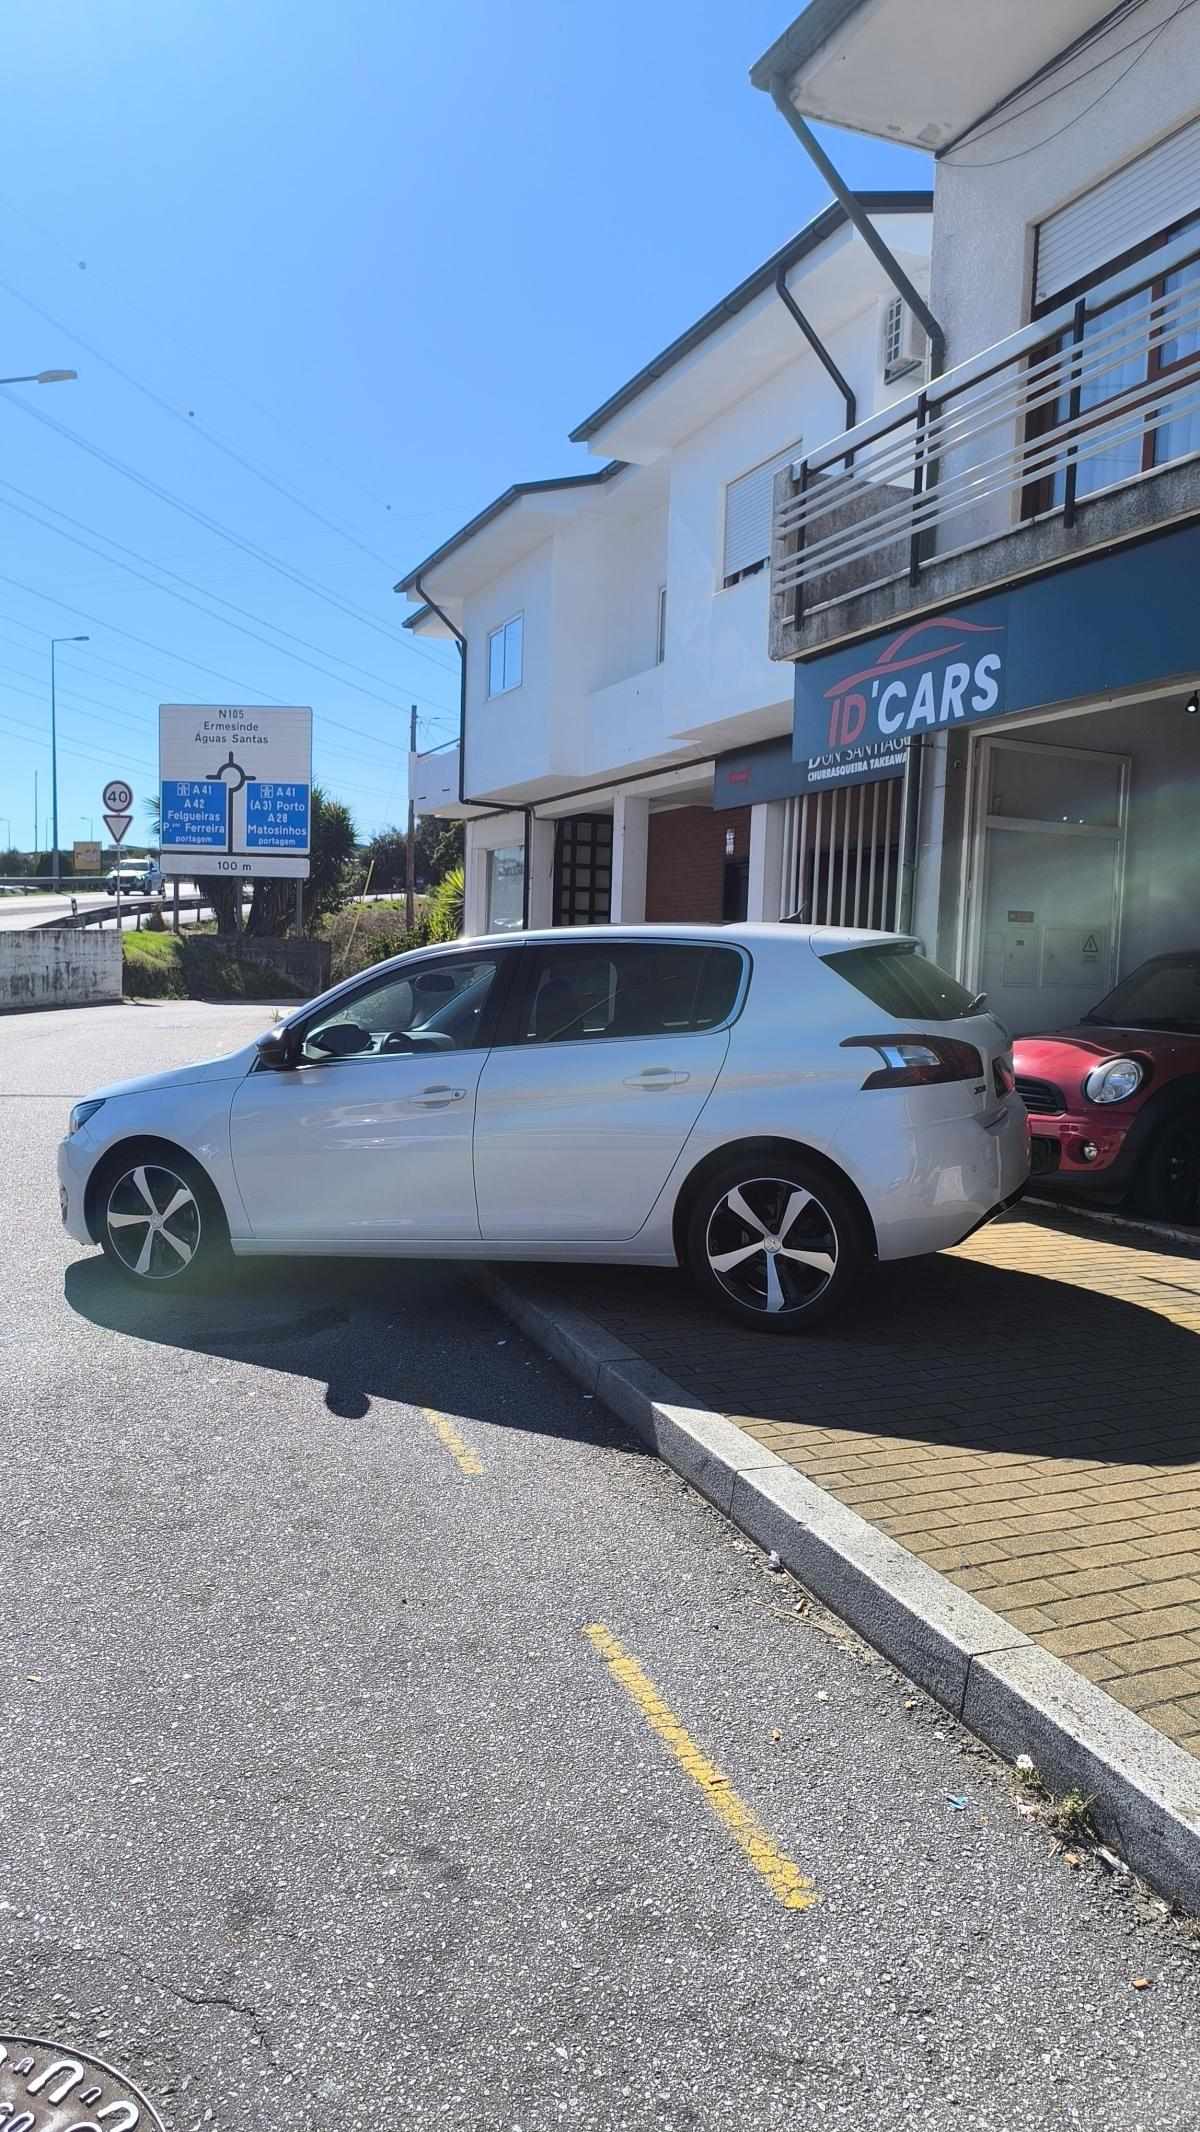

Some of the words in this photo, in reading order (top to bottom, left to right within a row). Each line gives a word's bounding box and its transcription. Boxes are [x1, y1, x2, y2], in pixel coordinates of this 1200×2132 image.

[218, 709, 244, 719] N105
[203, 720, 259, 732] Ermesinde
[231, 734, 269, 744] Santas
[807, 760, 868, 782] CHURRASQUEIRA
[869, 752, 909, 769] TAKEAWA
[107, 791, 126, 803] 40
[277, 801, 305, 811] Porto
[167, 810, 221, 822] Felgueiras
[184, 822, 225, 833] Ferreira
[247, 824, 307, 836] Matosinhos
[175, 835, 213, 844] portagem
[258, 837, 296, 847] portagem
[217, 861, 238, 871] 100
[242, 863, 252, 871] m
